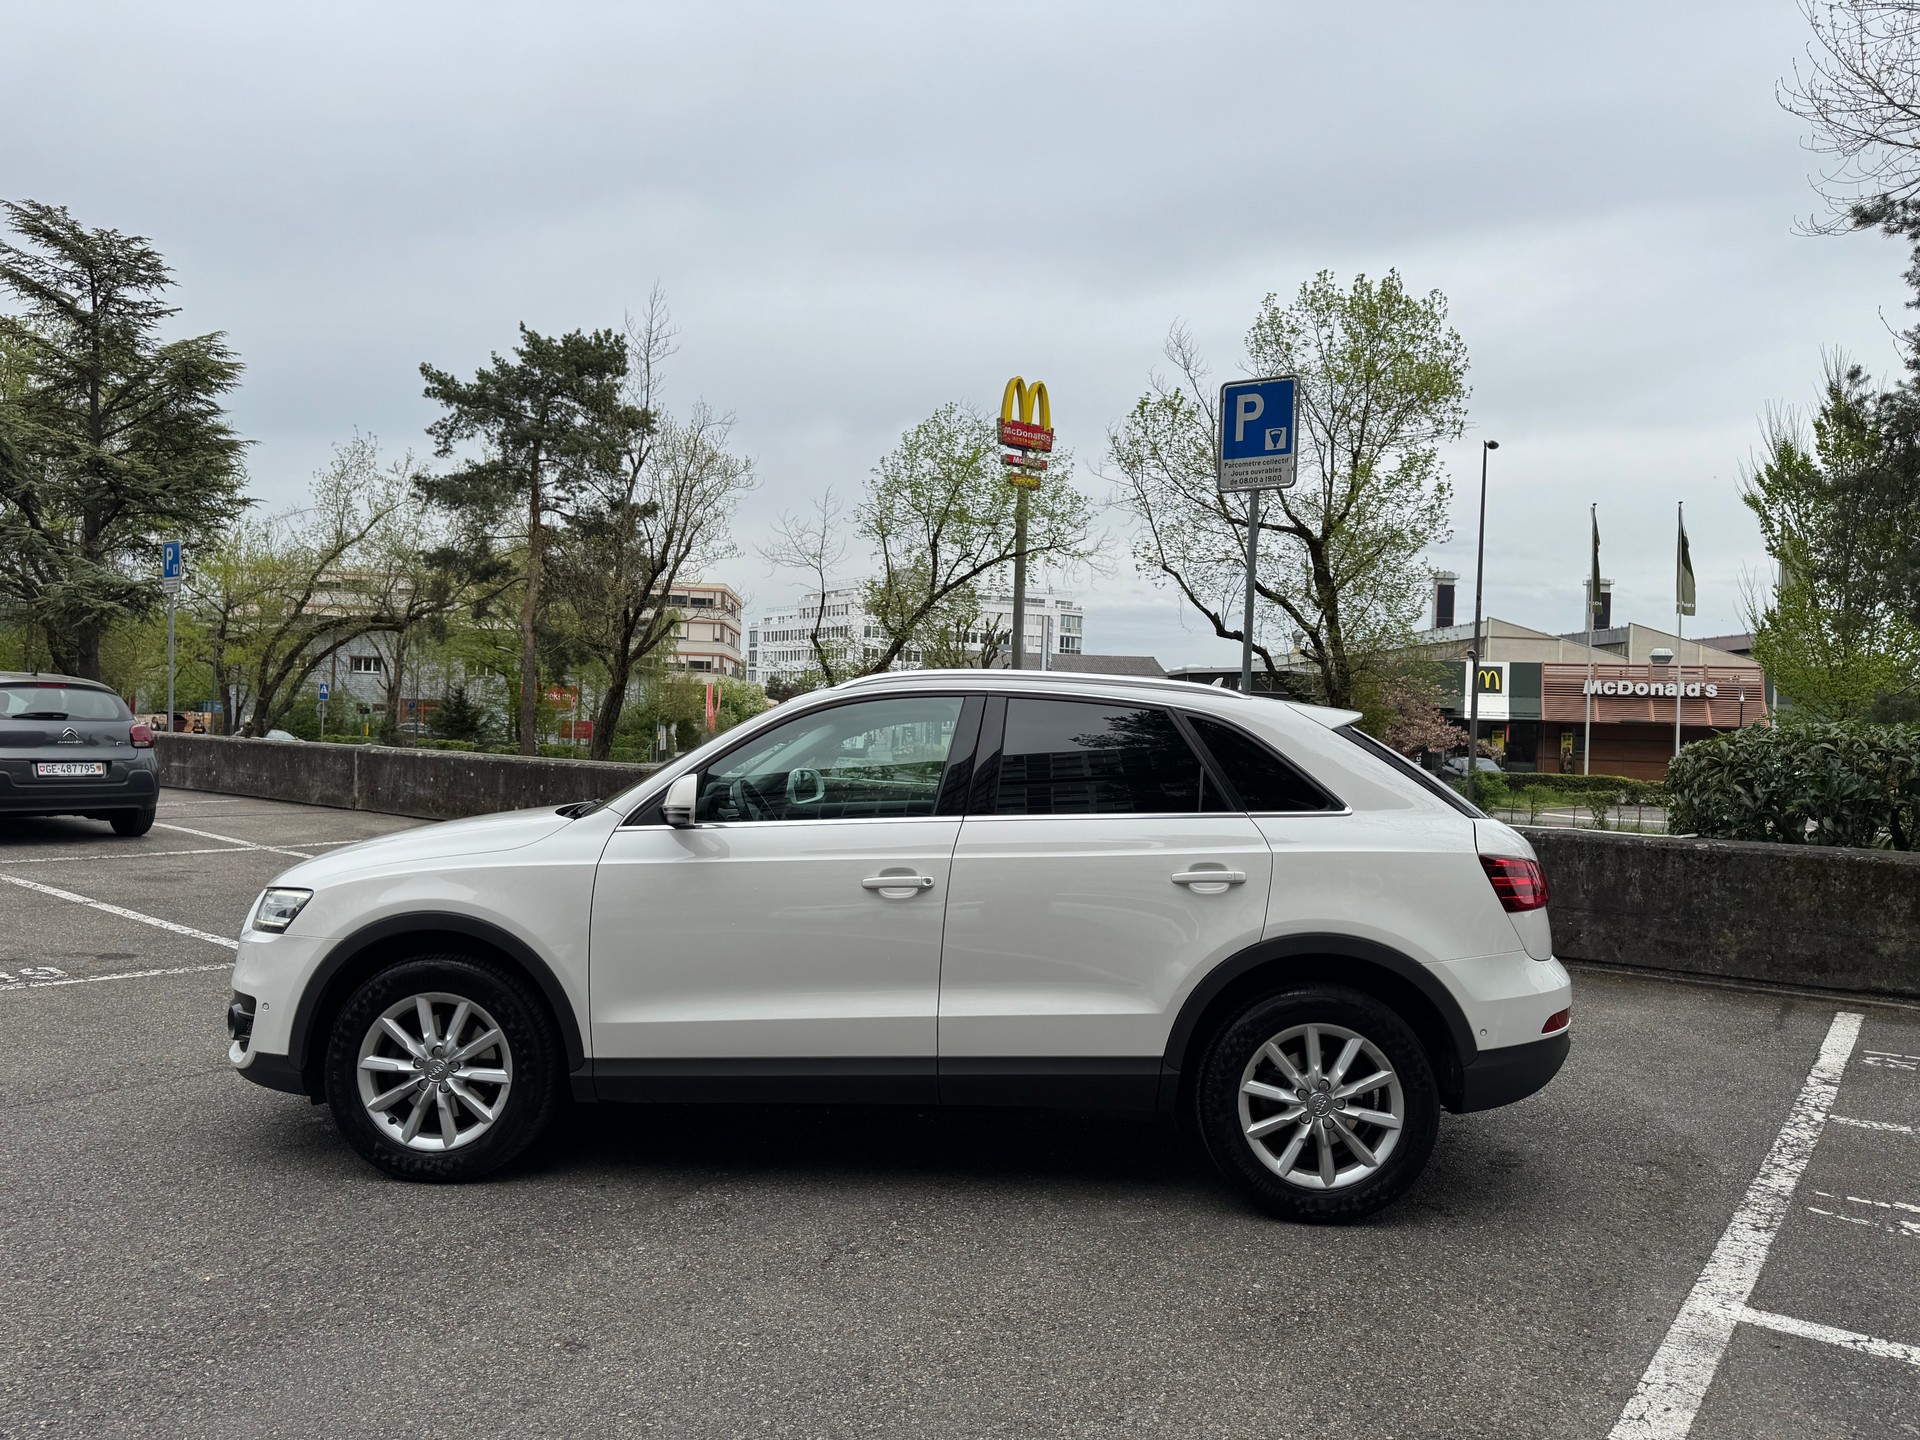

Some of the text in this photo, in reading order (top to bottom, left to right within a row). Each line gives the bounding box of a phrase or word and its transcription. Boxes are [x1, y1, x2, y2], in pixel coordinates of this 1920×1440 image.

[1235, 393, 1265, 442] P
[1224, 457, 1290, 469] Parcomètre collectif
[1250, 467, 1282, 476] ouvrables
[1229, 478, 1238, 486] de
[166, 547, 174, 570] P
[1583, 679, 1718, 698] McDonald's
